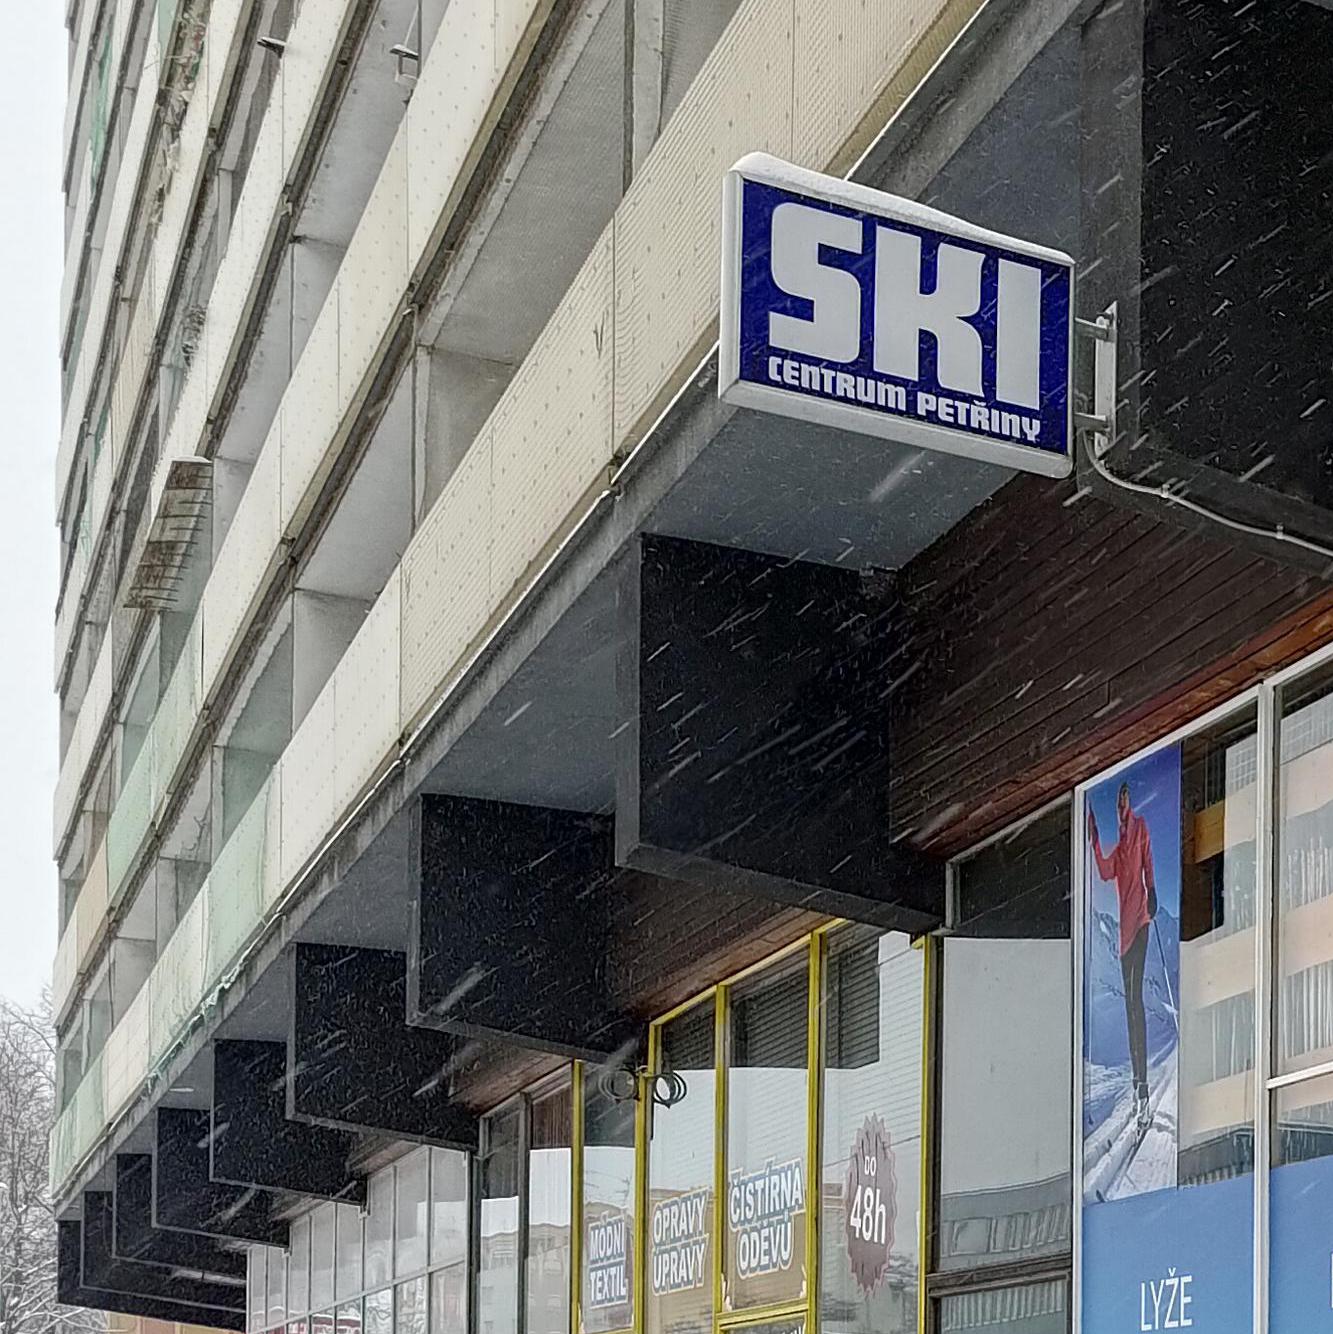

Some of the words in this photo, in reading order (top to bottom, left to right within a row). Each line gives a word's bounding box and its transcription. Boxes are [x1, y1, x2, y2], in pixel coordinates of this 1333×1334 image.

[768, 202, 1041, 410] SKI
[768, 356, 907, 411] CENTRUM
[917, 400, 1041, 442] PETŘINY
[864, 1155, 876, 1176] DO
[654, 1195, 705, 1243] OPRAVY
[731, 1167, 802, 1224] ČISTÍRNA
[850, 1184, 886, 1244] 48h
[740, 1211, 791, 1270] ODĚVŮ
[590, 1265, 627, 1301] TEXTIL
[1140, 1267, 1193, 1332] LYŽE
